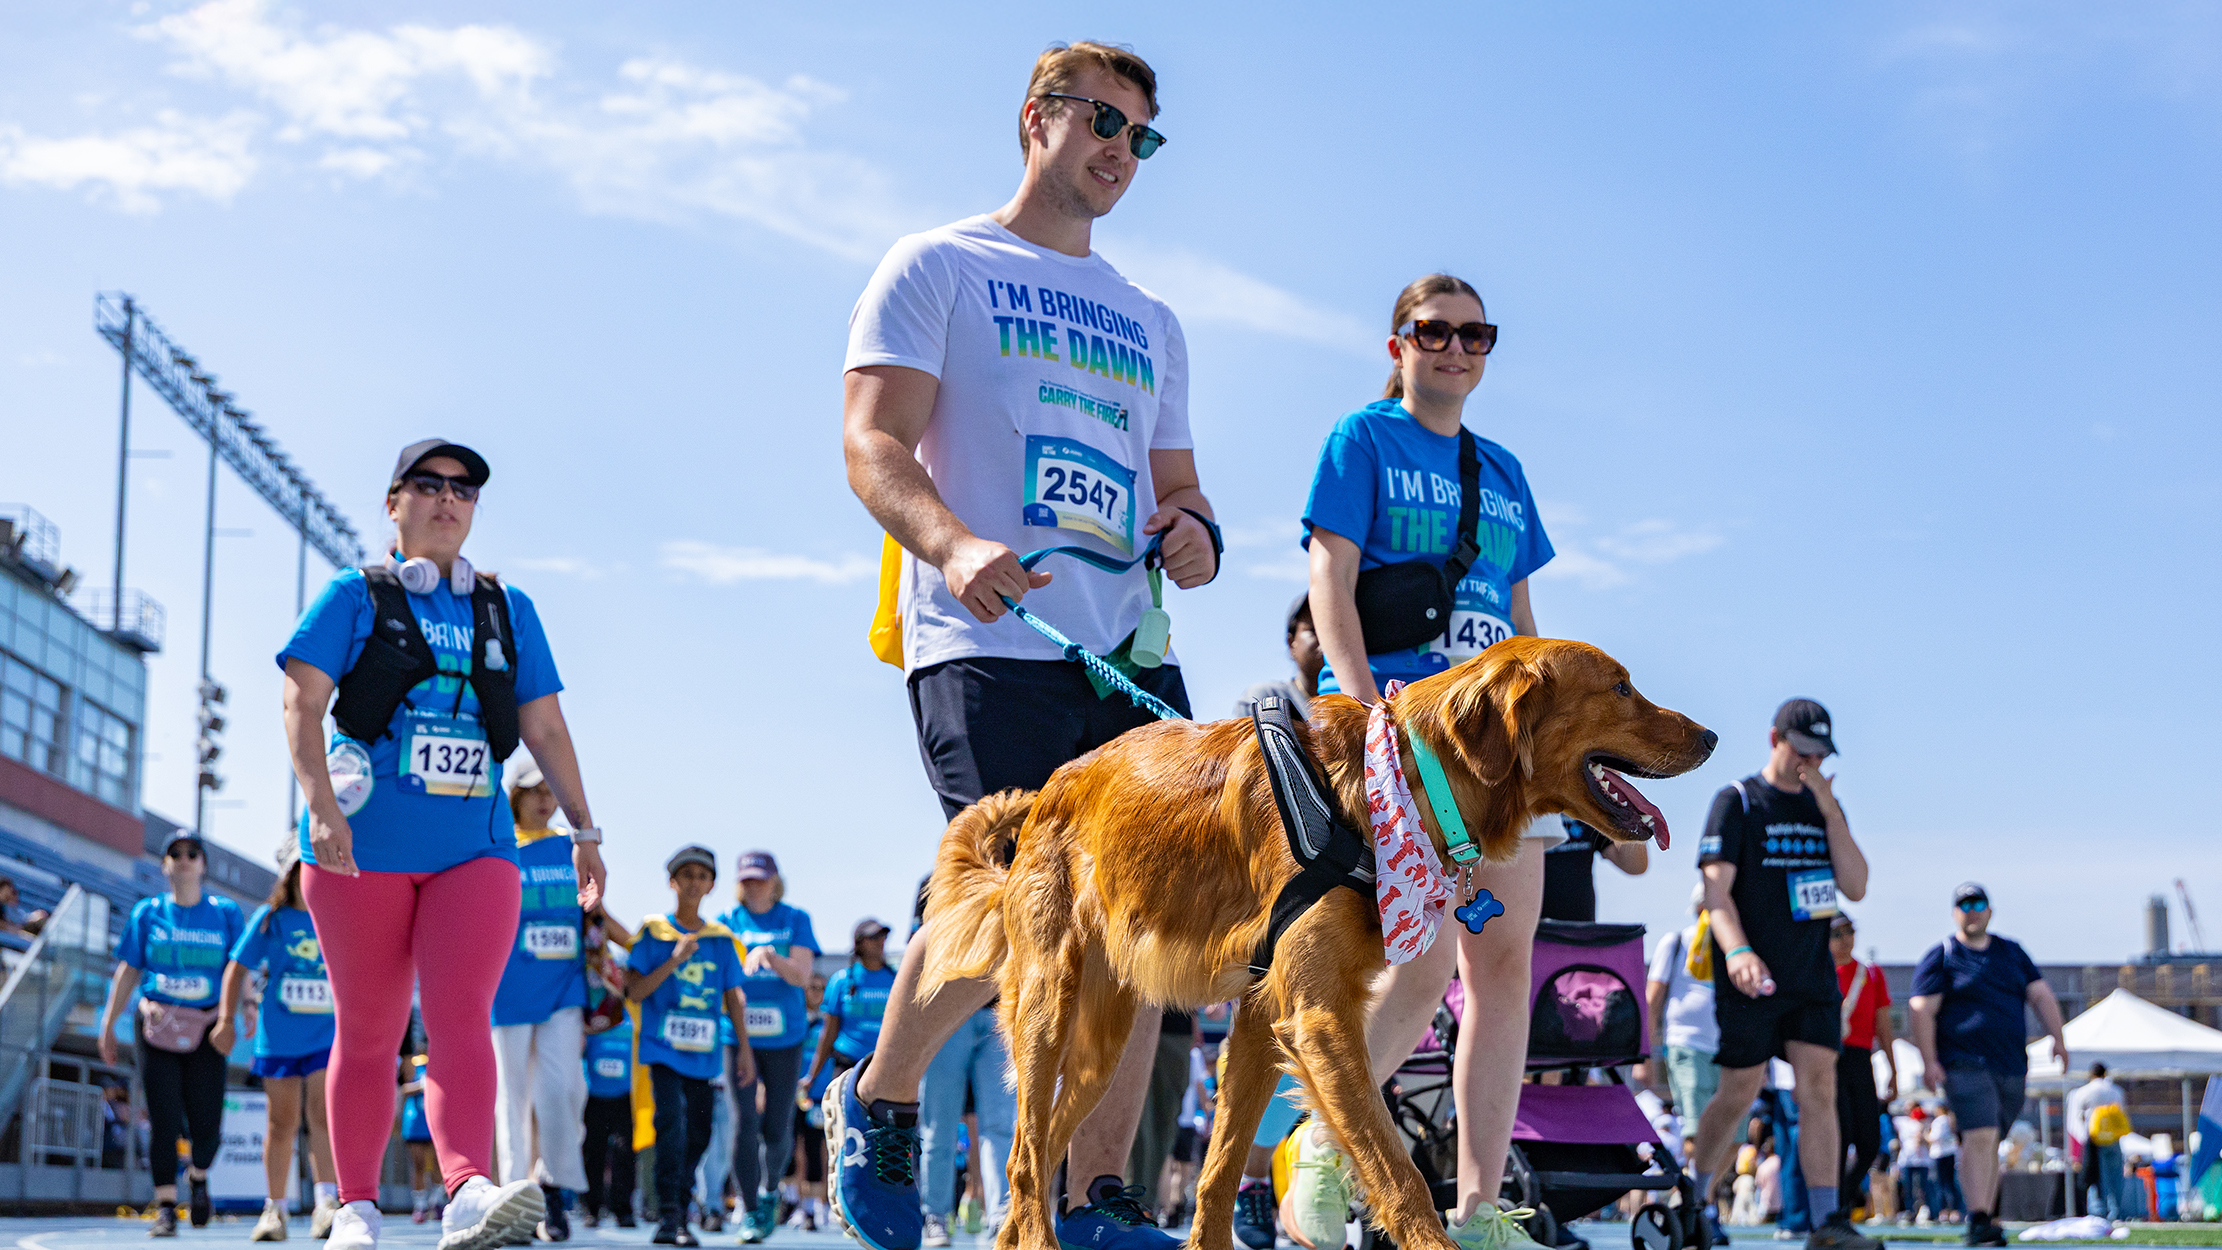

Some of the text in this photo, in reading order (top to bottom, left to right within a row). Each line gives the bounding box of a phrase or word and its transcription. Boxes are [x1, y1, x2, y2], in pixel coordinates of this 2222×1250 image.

[987, 278, 1149, 350] I'M BRINGING
[993, 315, 1155, 396] THE DAWN
[1038, 385, 1119, 426] CARRY THE FIRE
[1043, 466, 1118, 520] 2547
[1386, 466, 1525, 532] I'M BRGING
[1388, 507, 1449, 555] THE
[420, 618, 474, 651] BRIN
[418, 743, 483, 776] 1322
